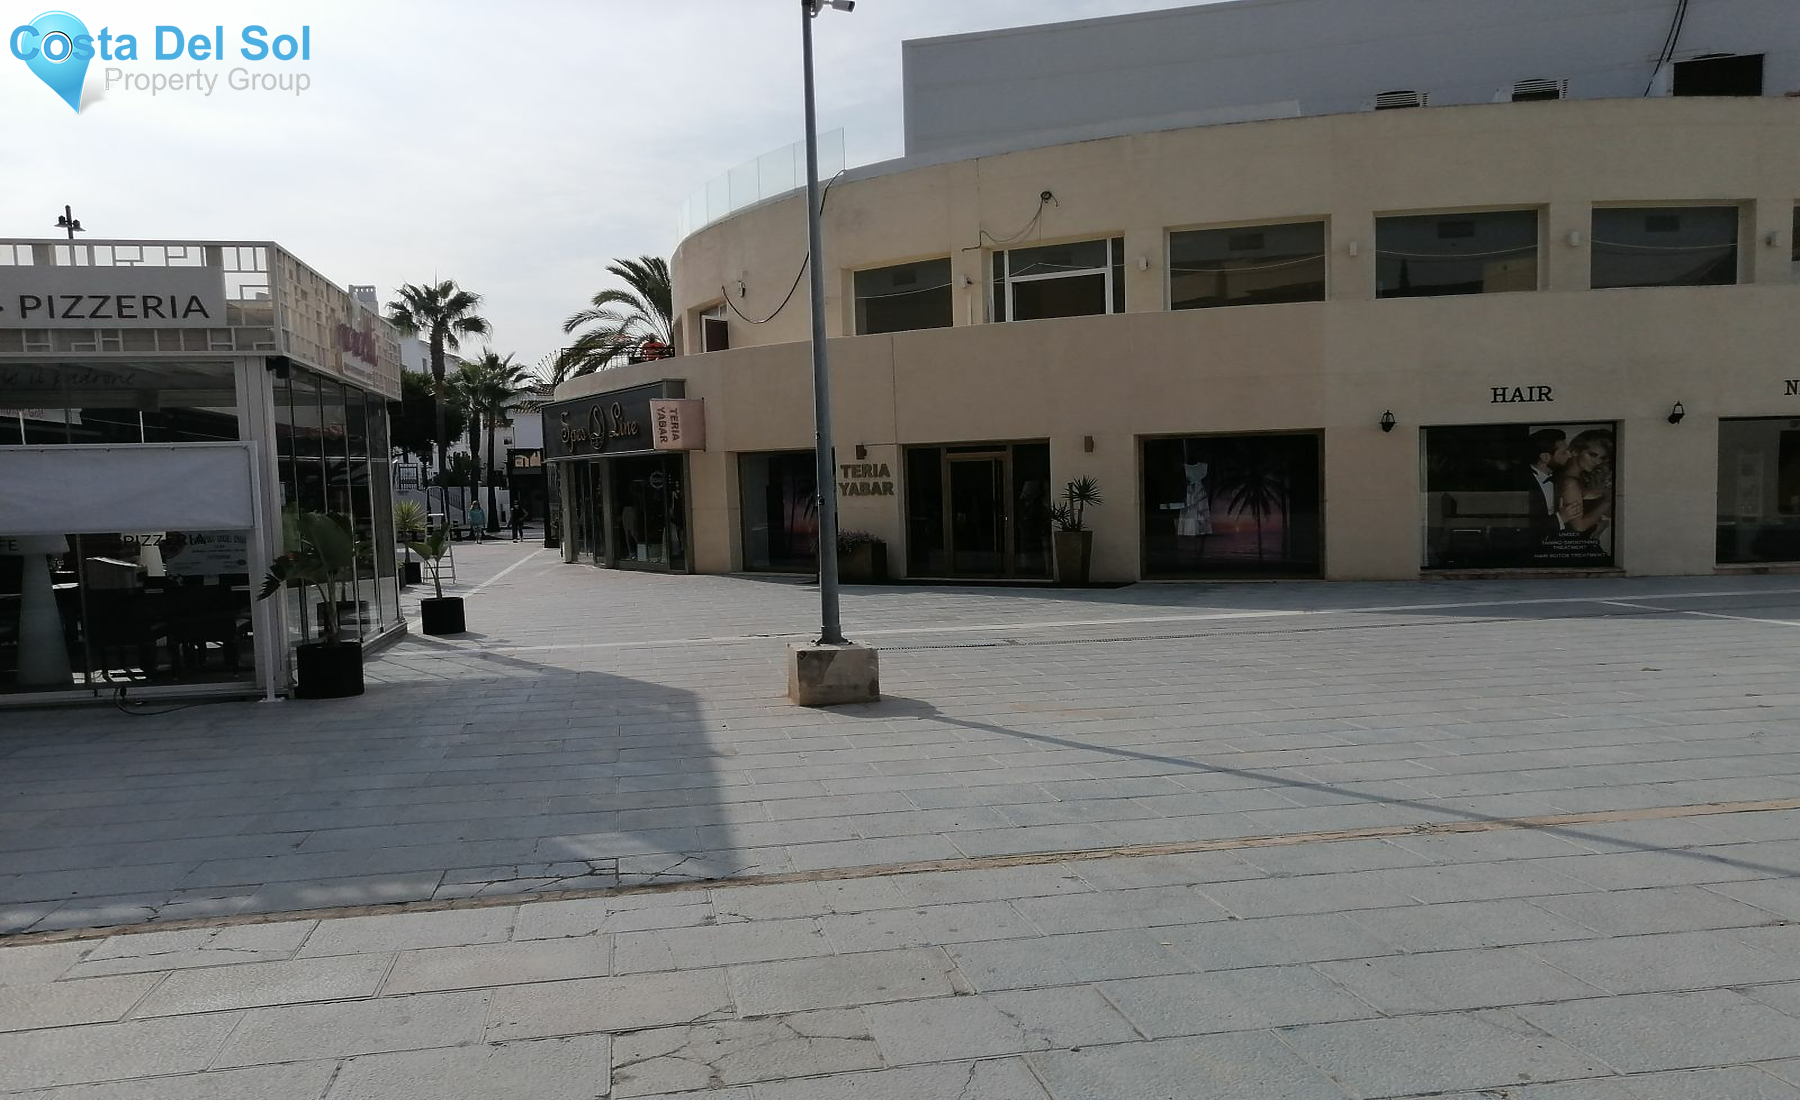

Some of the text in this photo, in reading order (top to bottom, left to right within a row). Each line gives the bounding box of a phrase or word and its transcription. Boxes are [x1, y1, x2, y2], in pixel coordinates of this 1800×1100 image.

[19, 294, 210, 319] PIZZERIA
[1490, 385, 1553, 403] HAIR
[609, 401, 639, 438] Line
[657, 406, 669, 443] YABAR
[669, 407, 681, 441] TERIA
[840, 463, 891, 480] TERIA
[838, 481, 894, 497] YABAR
